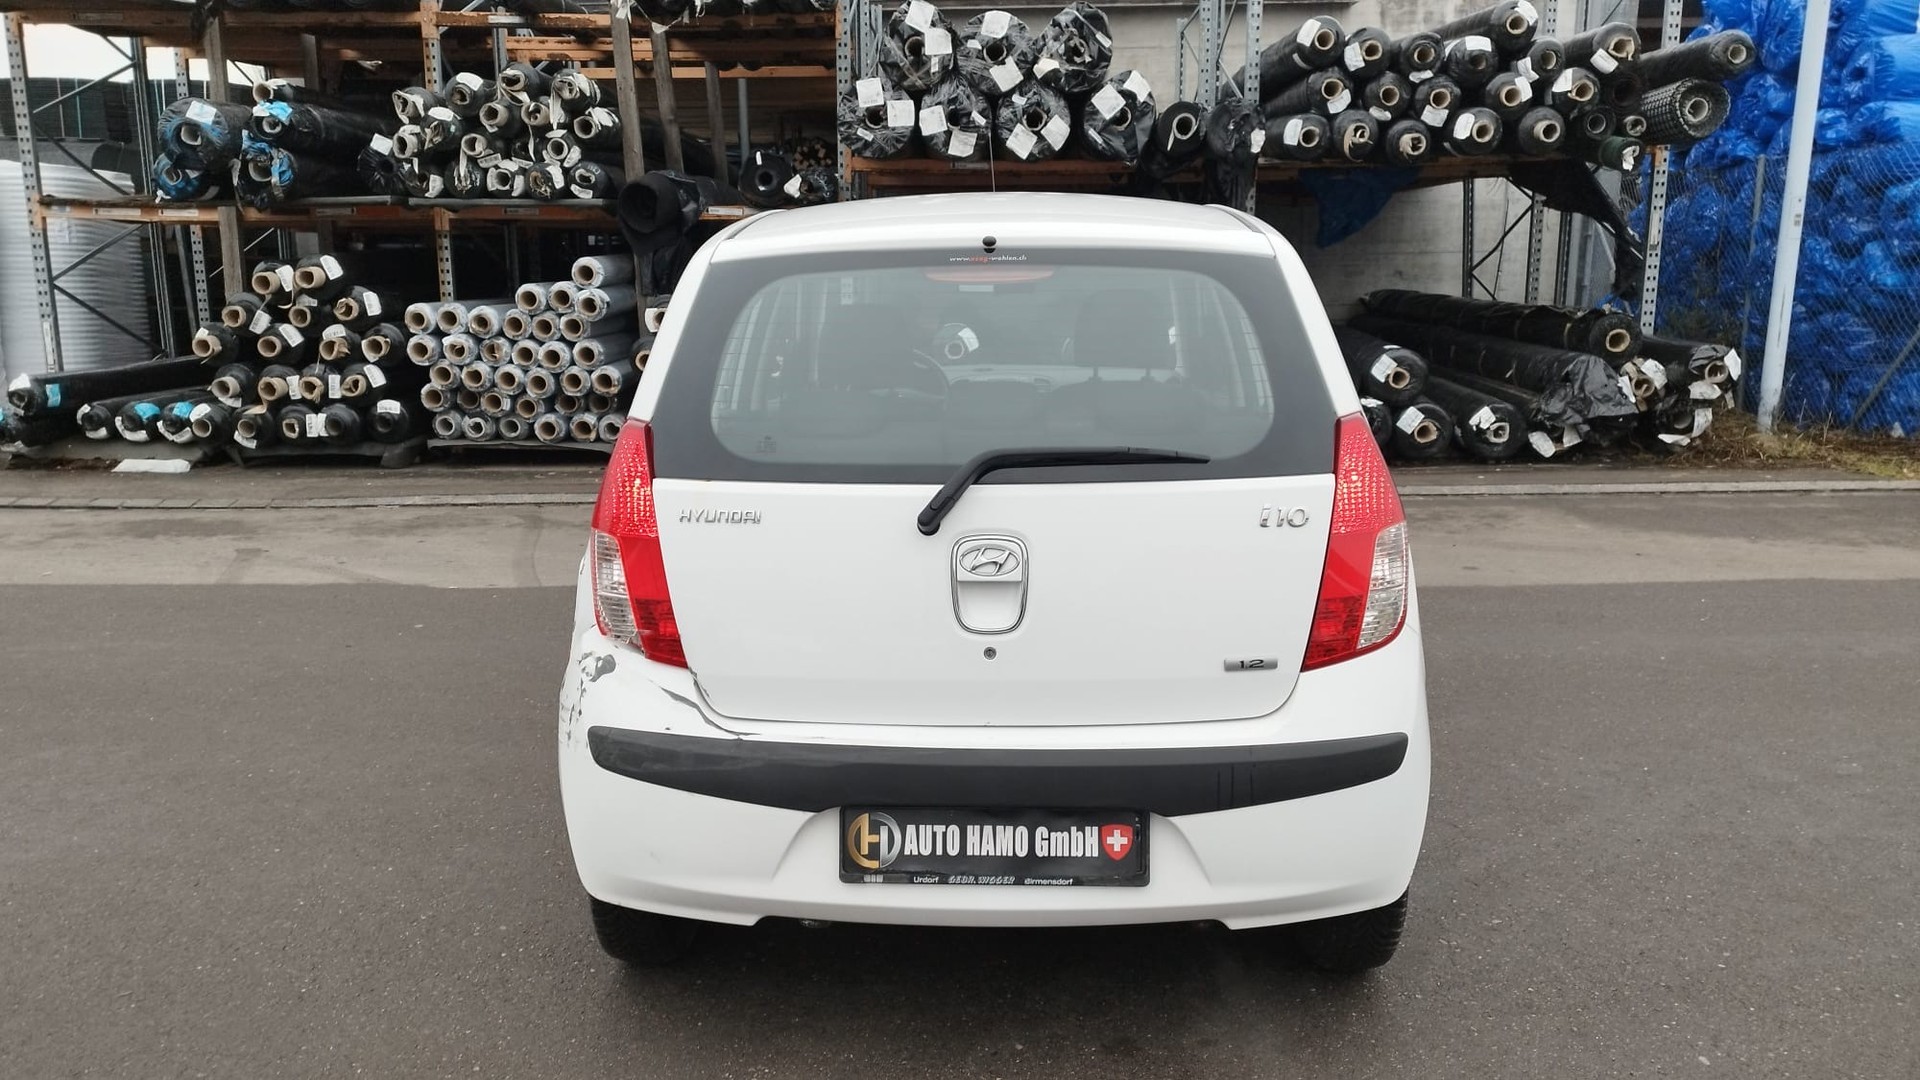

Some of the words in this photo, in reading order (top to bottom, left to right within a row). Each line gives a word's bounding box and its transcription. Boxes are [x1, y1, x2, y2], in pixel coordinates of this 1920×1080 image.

[679, 508, 761, 524] HYUNDAI
[1259, 503, 1310, 528] i10
[1239, 658, 1265, 669] 1.2
[904, 824, 960, 856] AUTO
[966, 825, 1029, 857] HAMO
[1034, 825, 1099, 858] GmbH
[912, 876, 939, 884] Urdorf
